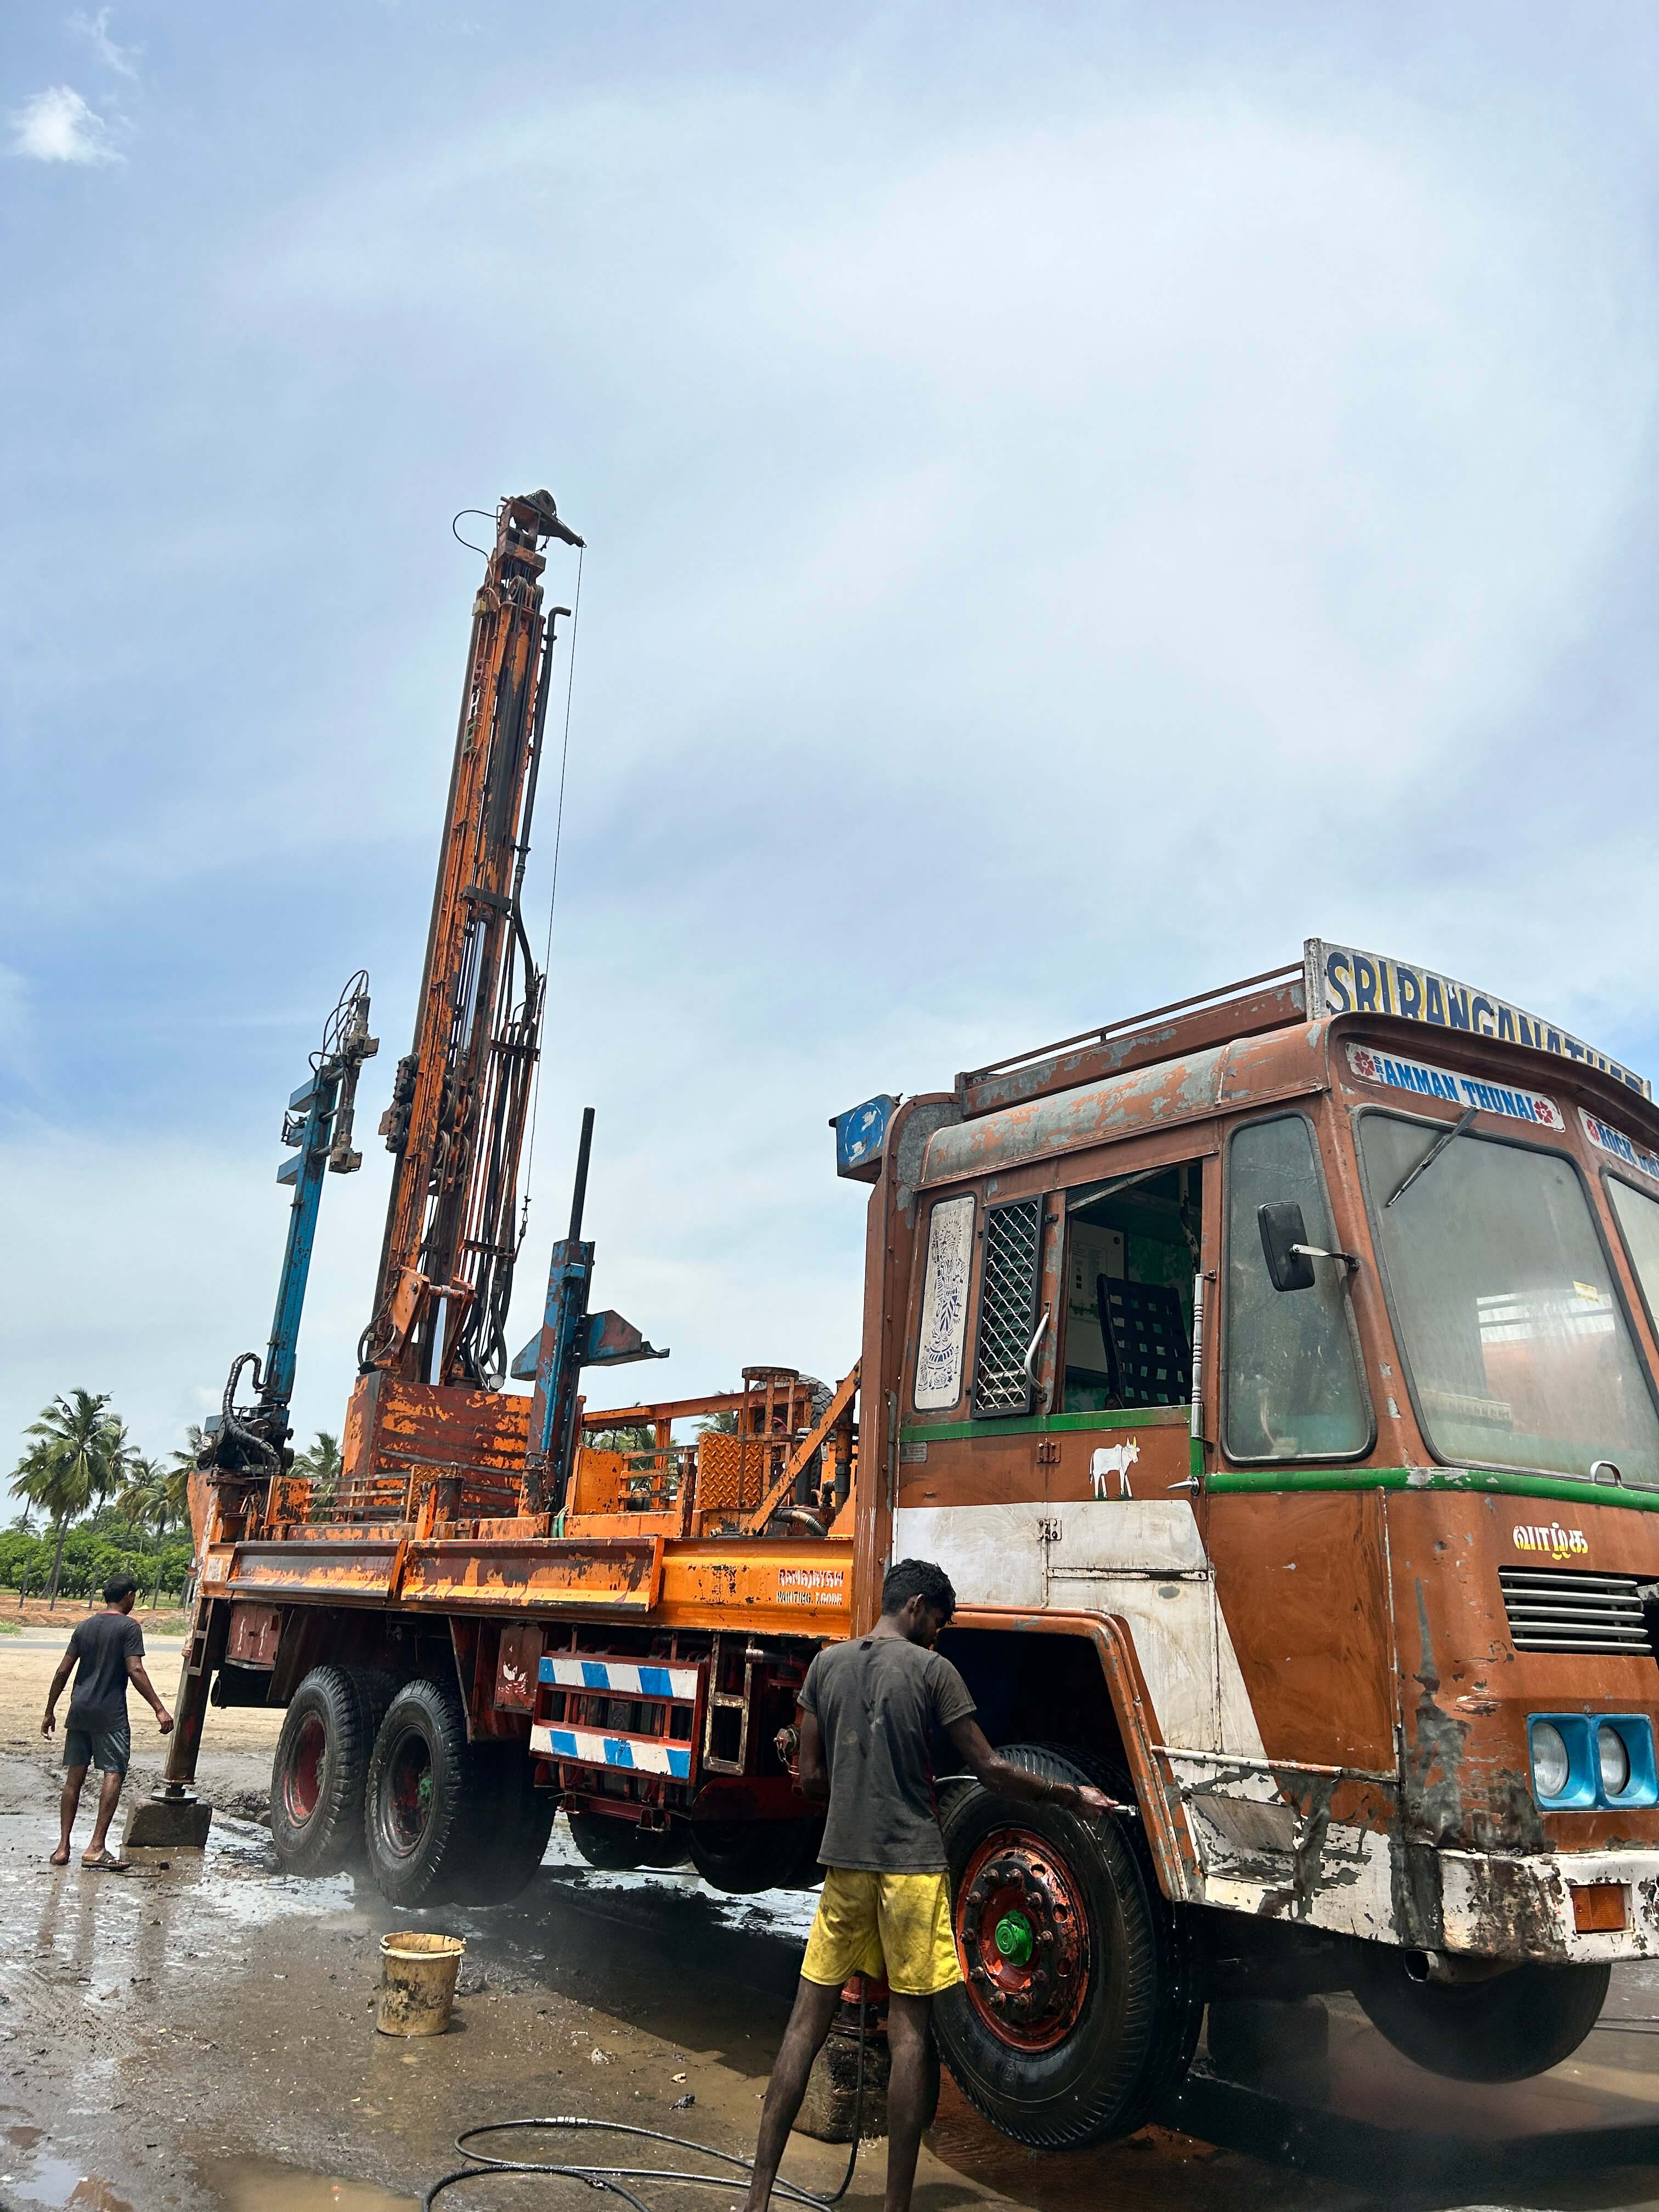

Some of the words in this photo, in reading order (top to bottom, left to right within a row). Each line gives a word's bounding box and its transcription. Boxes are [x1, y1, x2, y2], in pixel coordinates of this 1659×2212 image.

[1373, 1056, 1384, 1083] SRI
[1384, 1059, 1460, 1102] AMMAN
[1459, 1079, 1538, 1121] THUNAI
[1595, 1122, 1637, 1166] ROCK
[1513, 1522, 1589, 1560] வாழ்க
